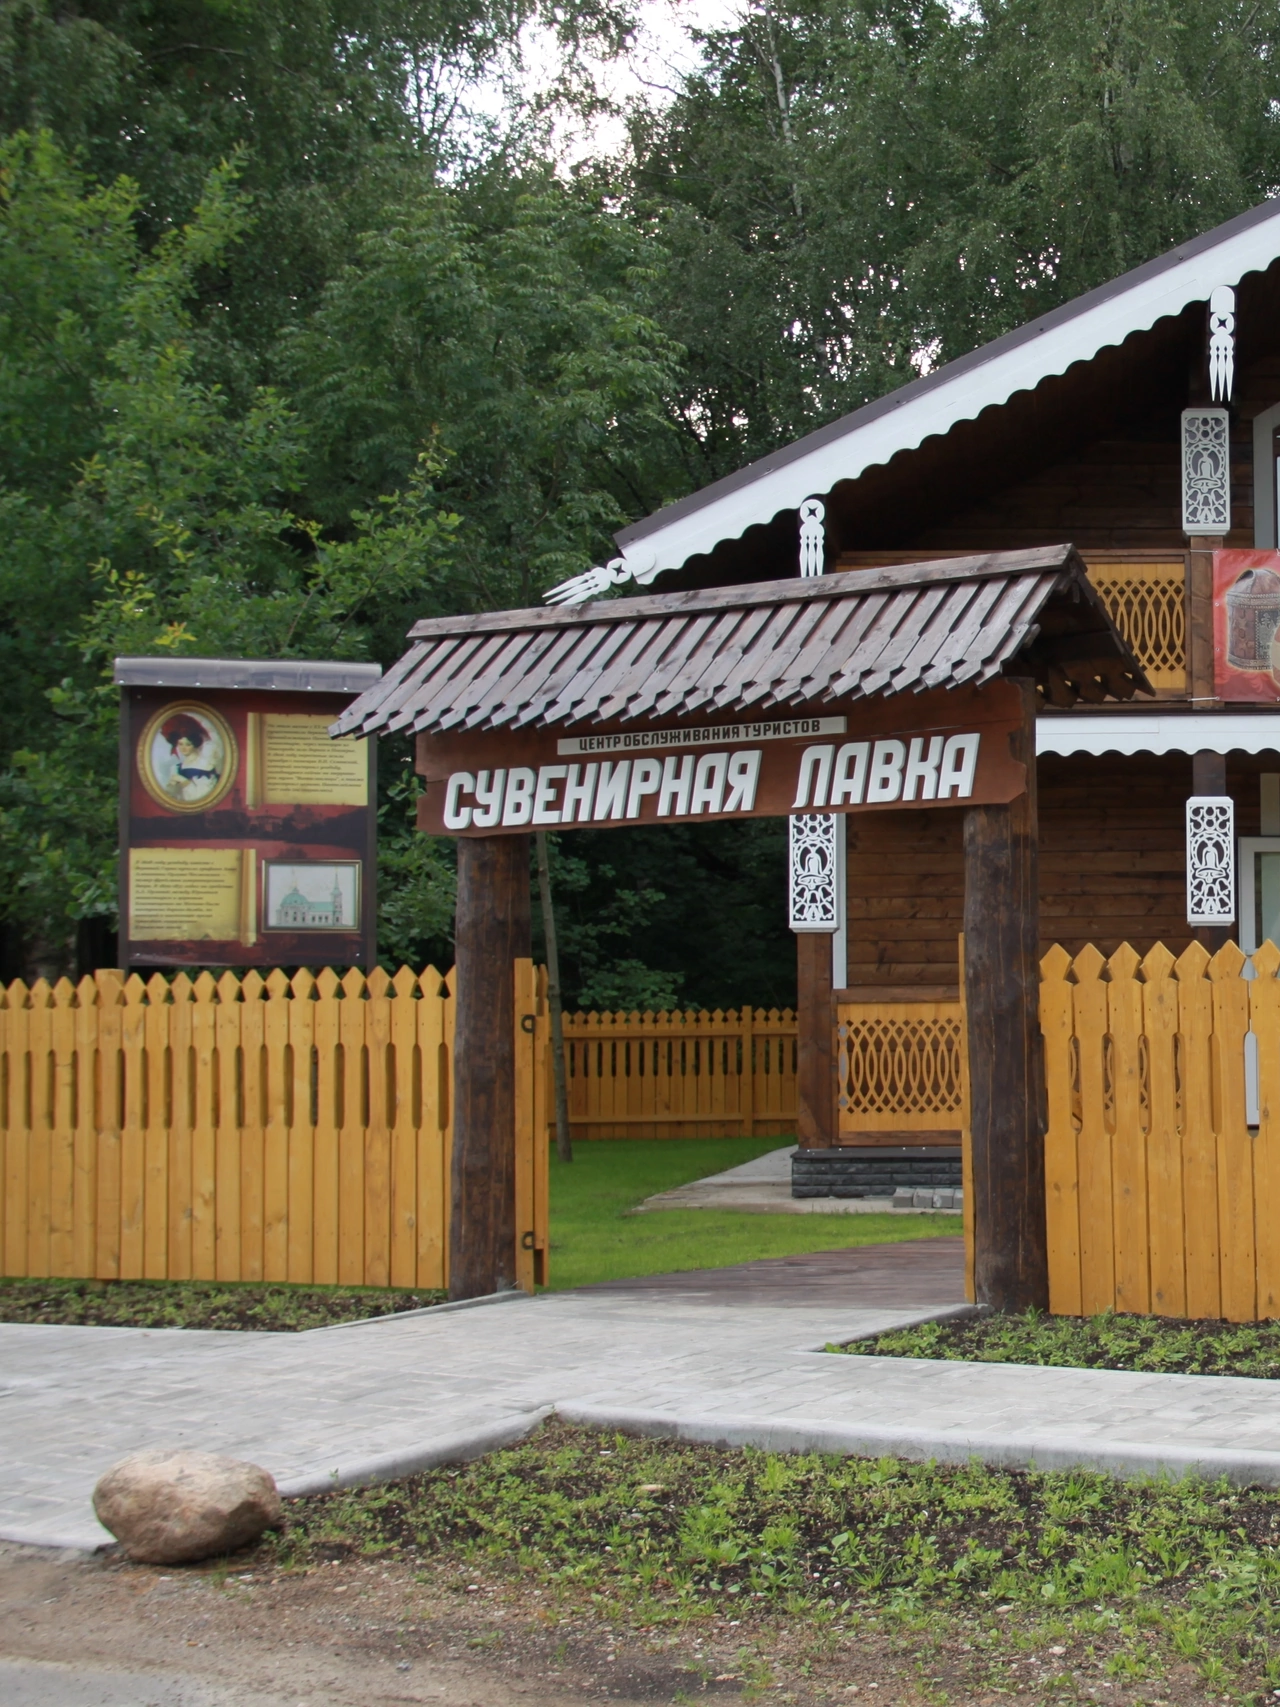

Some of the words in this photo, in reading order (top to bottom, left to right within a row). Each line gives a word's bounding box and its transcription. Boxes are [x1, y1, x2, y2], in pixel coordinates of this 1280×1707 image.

[579, 734, 621, 751] ЦЕНТР
[623, 726, 740, 747] ОБСЛУЖИВАНИЯ
[743, 720, 821, 739] ТУРИСТОВ
[443, 750, 762, 831] СУВЕНИРНАЯ
[791, 733, 982, 809] ЛАВКА
